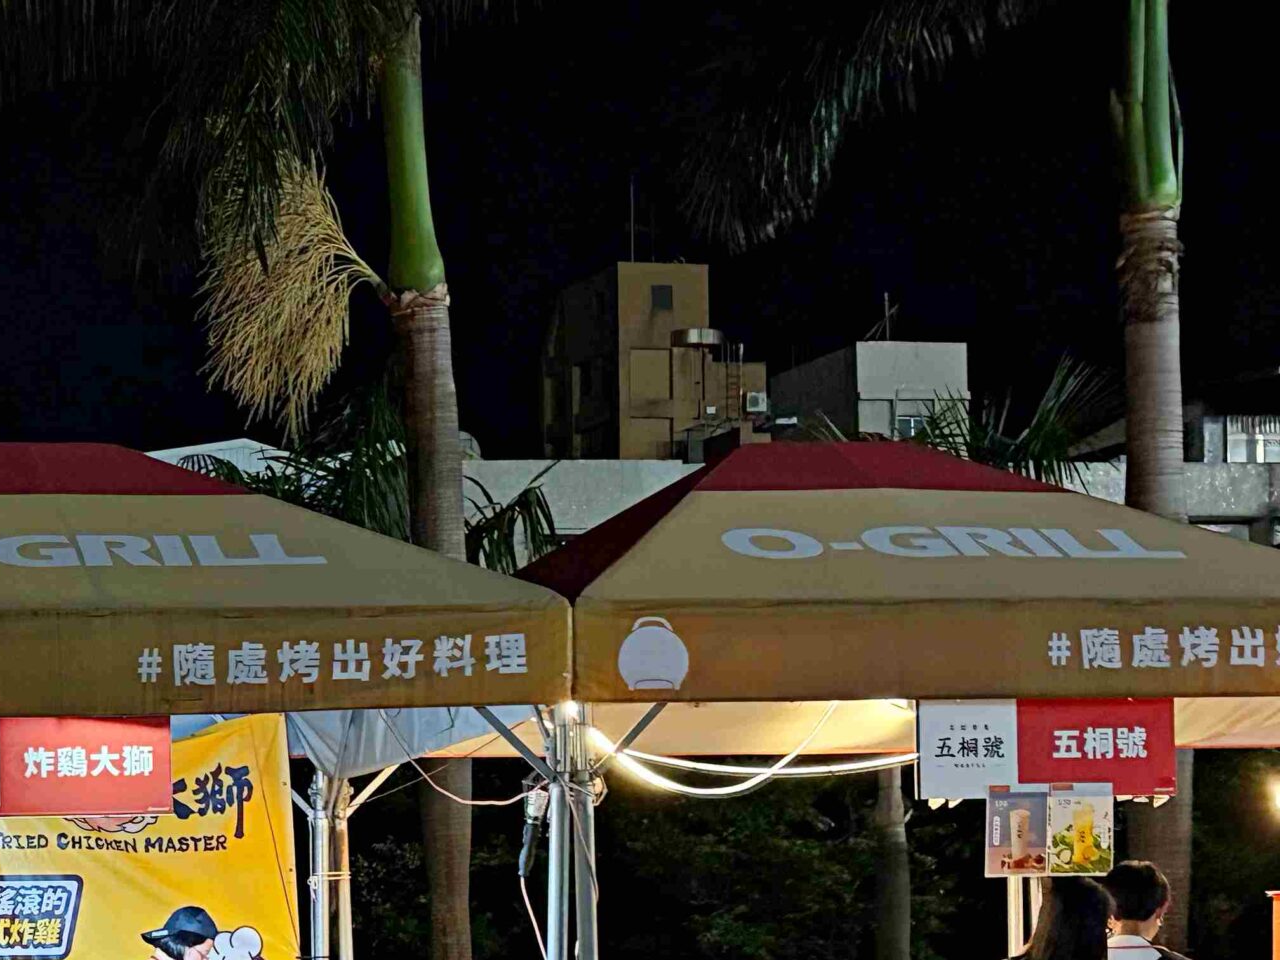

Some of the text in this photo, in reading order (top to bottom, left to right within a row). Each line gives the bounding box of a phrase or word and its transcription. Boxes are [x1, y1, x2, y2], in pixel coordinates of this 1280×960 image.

[721, 525, 1188, 560] O-GRILL
[1048, 626, 1280, 669] #隨處烤出
[934, 736, 1005, 759] 五桐號
[1052, 726, 1148, 759] 五桐號
[56, 832, 138, 853] CHICKEN
[144, 834, 228, 854] MASTER
